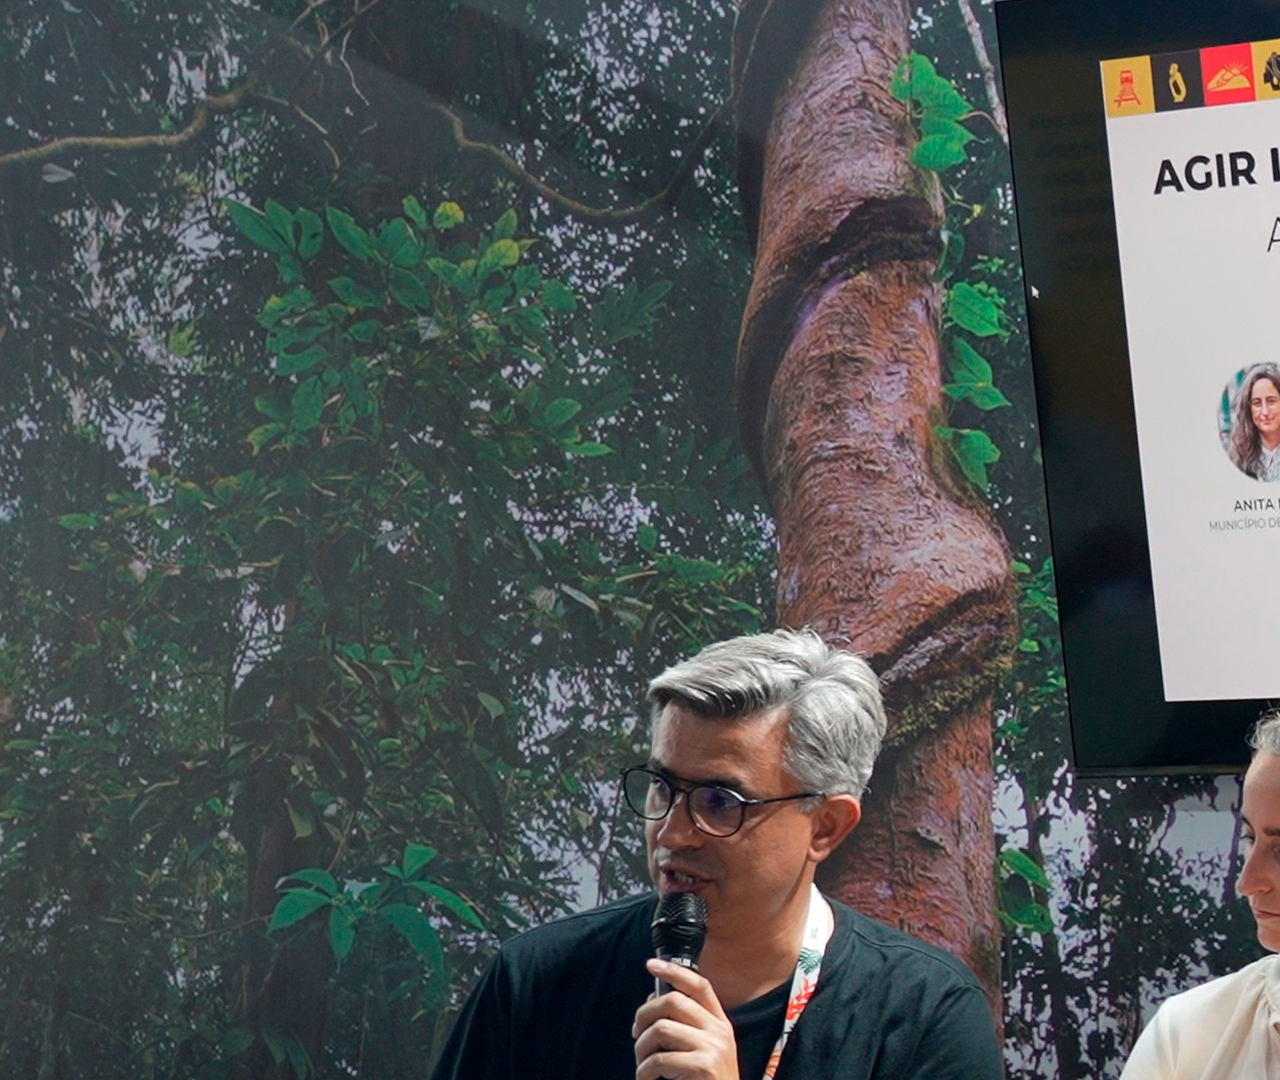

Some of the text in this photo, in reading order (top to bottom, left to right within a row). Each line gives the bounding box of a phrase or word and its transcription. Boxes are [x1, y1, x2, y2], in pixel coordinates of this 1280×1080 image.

[1154, 151, 1258, 195] AGIR
[1234, 498, 1273, 512] ANITA
[1208, 517, 1266, 531] MUNICÍPIO
